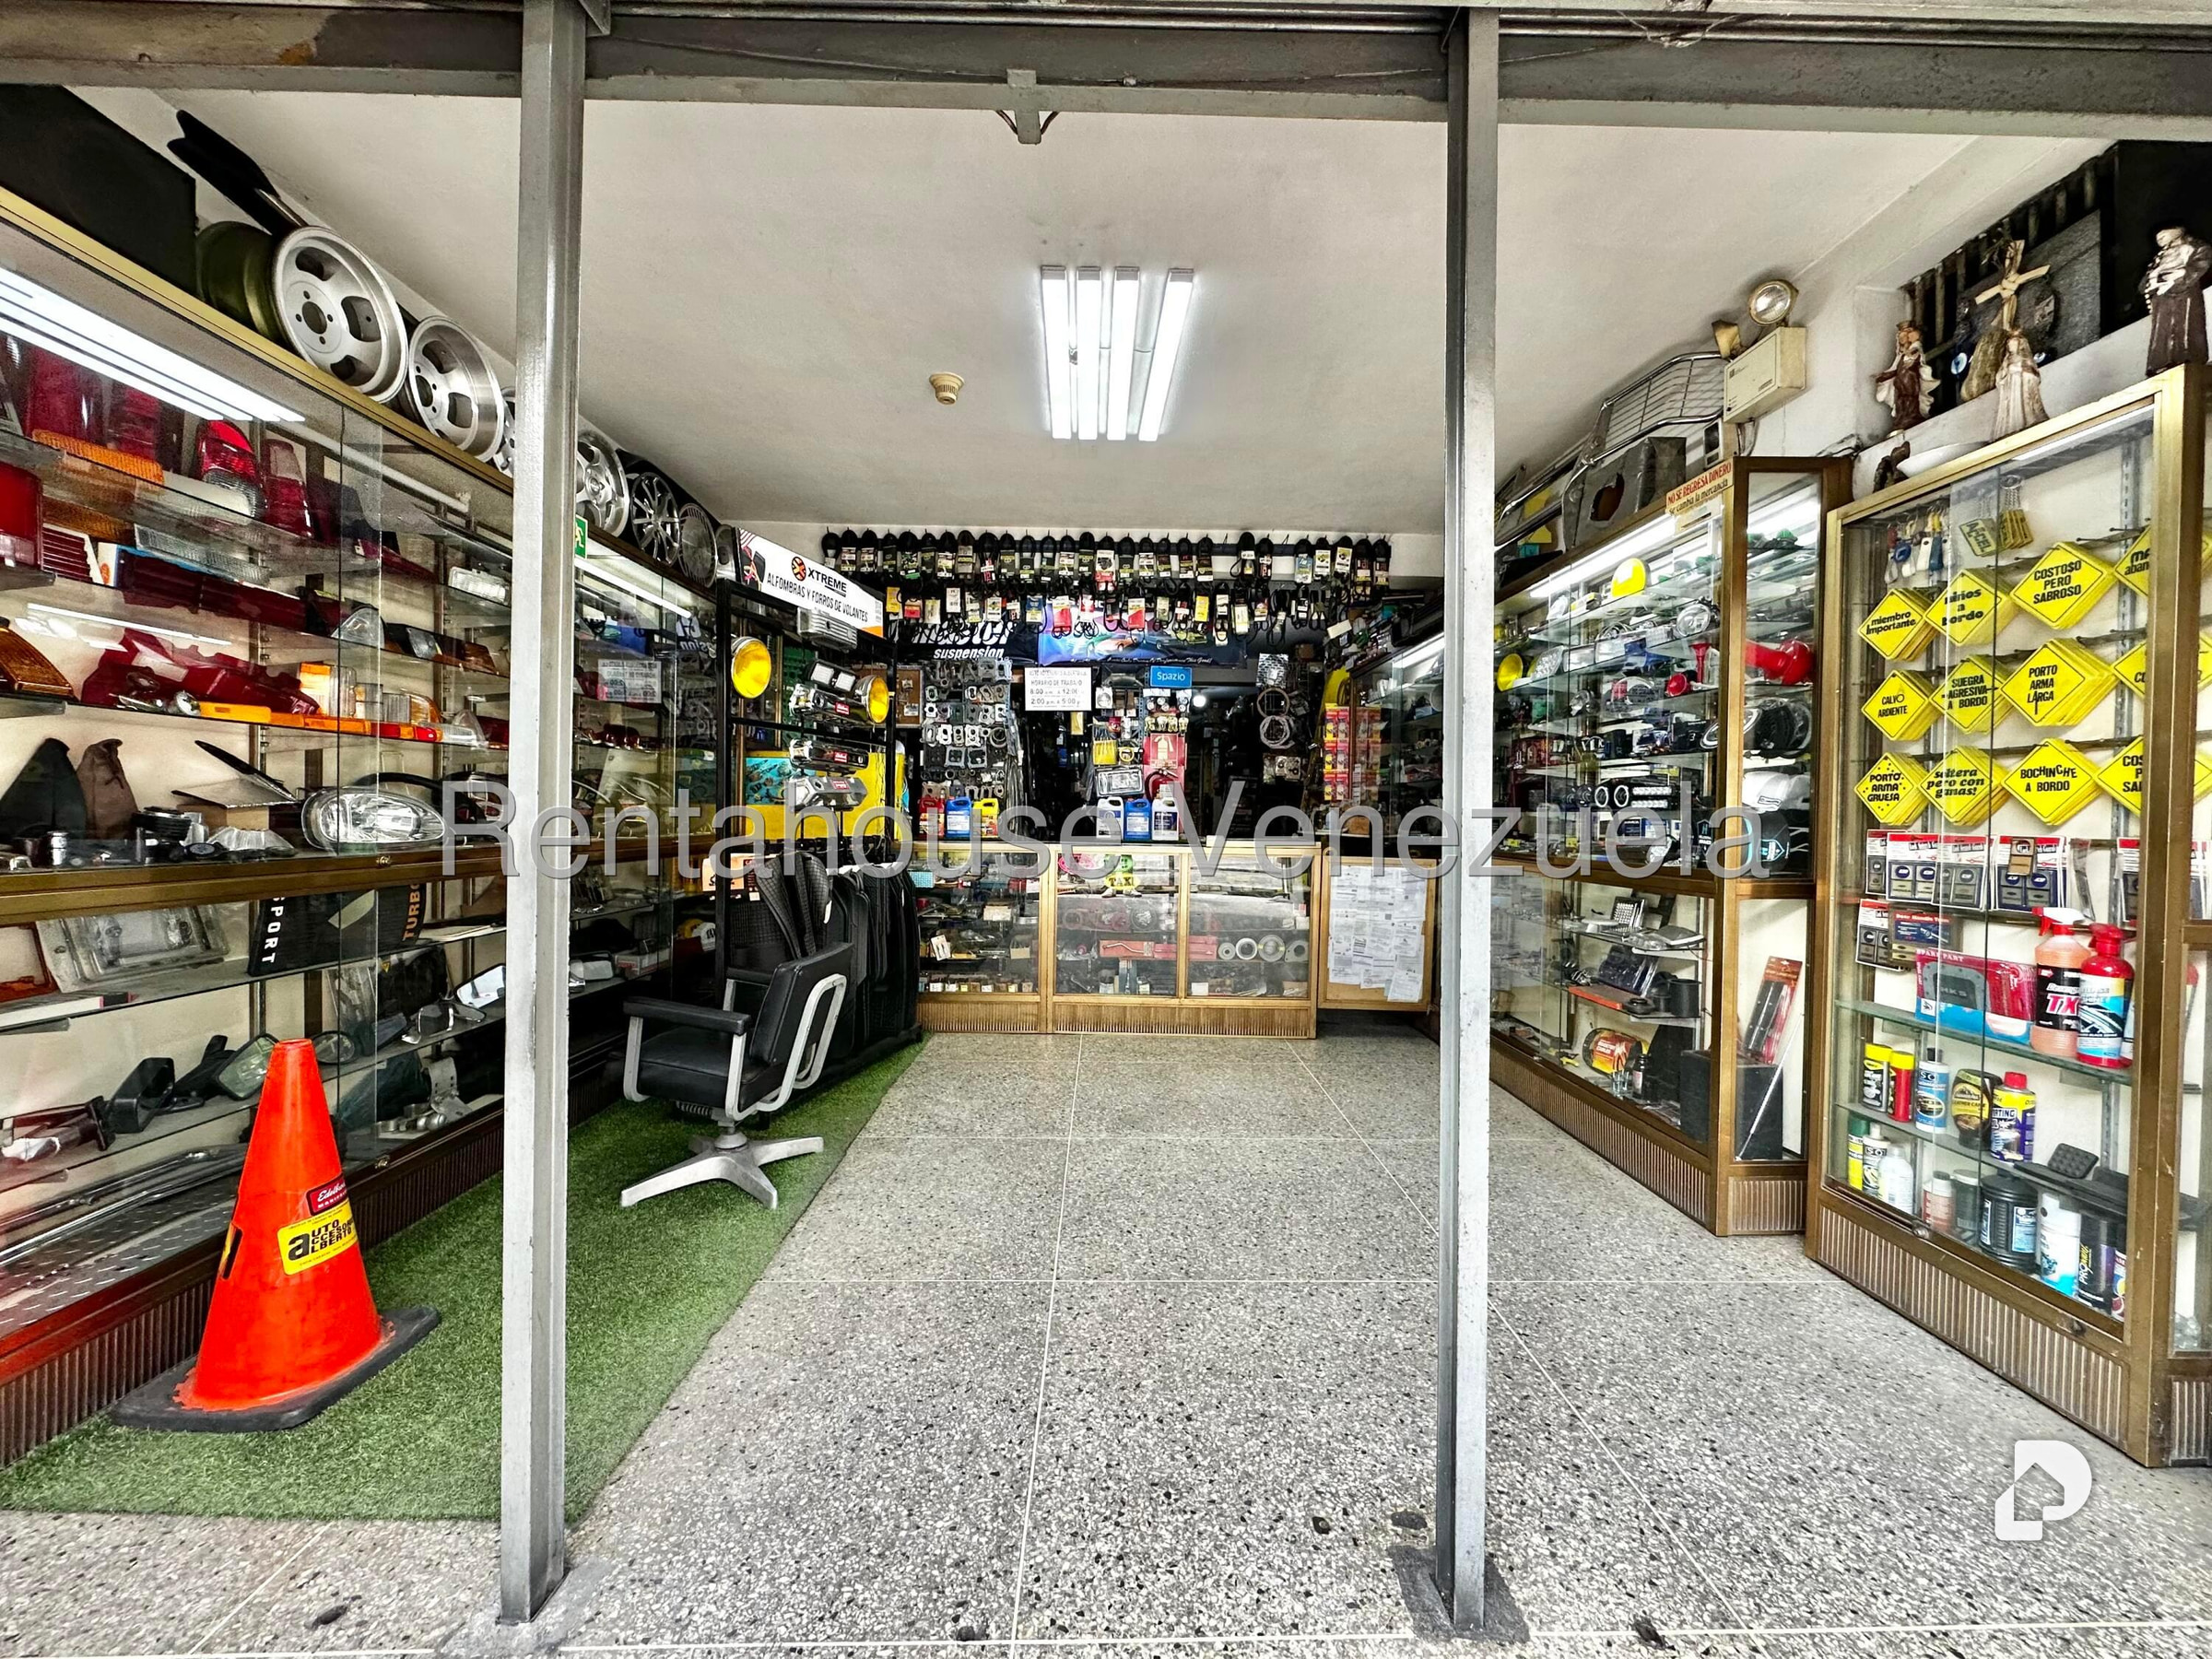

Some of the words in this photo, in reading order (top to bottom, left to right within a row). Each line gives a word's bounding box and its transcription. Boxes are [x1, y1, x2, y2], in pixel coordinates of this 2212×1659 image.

[1683, 474, 1709, 498] REGRESA
[1709, 462, 1732, 483] DINERO
[2033, 559, 2082, 581] COSTOSO
[807, 567, 847, 593] XTREME
[2043, 575, 2072, 591] PERO
[766, 572, 806, 598] ALFOMBRAS
[806, 589, 811, 600] Y
[812, 590, 834, 609] FORROS
[834, 599, 841, 612] DE
[842, 603, 868, 622] VOLANTES
[2033, 584, 2081, 605] SABROSO
[1871, 611, 1912, 626] miembro
[934, 646, 1005, 660] suspension
[1157, 671, 1185, 681] Spazio
[2029, 664, 2057, 677] PORTO
[1951, 675, 1984, 688] SUEGRA
[2030, 677, 2054, 690] ARMA
[1881, 693, 1905, 705] CALVO
[1947, 700, 1953, 710] A
[1959, 696, 1988, 709] BORDO
[2027, 690, 2054, 708] LARGA
[1877, 705, 1908, 718] ARDIENTE
[1869, 772, 1901, 782] PORTO
[2020, 764, 2077, 779] BOCHINCHE
[1871, 783, 1899, 793] ARMA
[1959, 778, 1984, 786] con
[2025, 782, 2031, 792] A
[2037, 781, 2070, 792] BORDO
[1866, 793, 1900, 802] GRUESA
[1109, 877, 1135, 888] TAXI
[1942, 953, 1964, 961] PART
